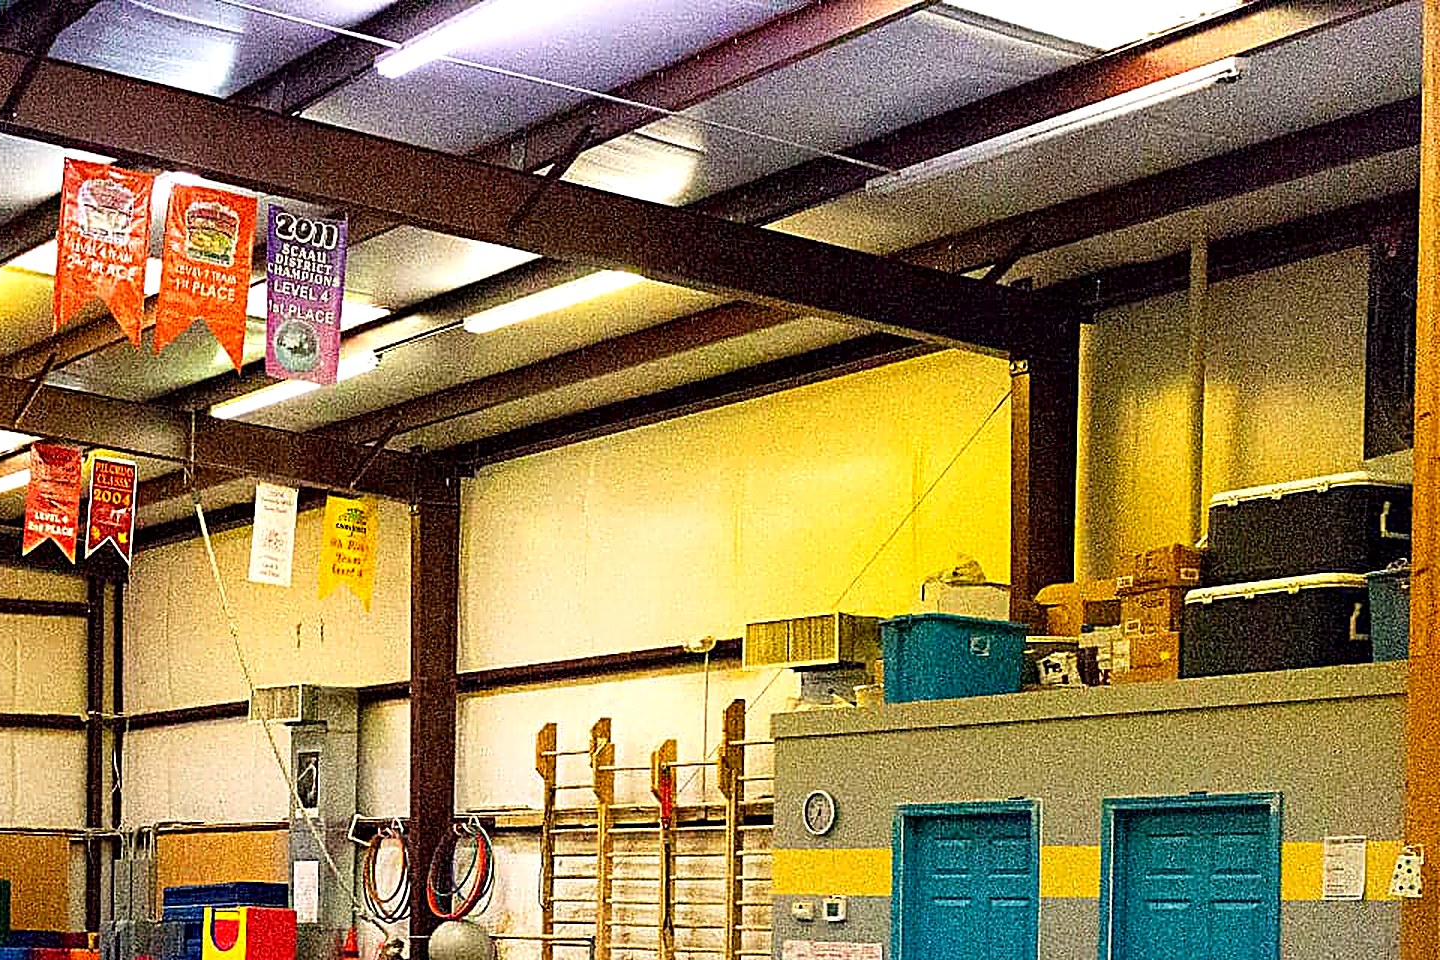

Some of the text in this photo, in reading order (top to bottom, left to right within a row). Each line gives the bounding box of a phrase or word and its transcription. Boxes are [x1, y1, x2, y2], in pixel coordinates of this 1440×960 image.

[275, 212, 339, 251] 2011
[275, 252, 334, 275] DISTRICT
[281, 242, 327, 265] SCAAU
[267, 262, 341, 289] CHAMPIONS
[191, 281, 236, 303] PLACE
[273, 278, 331, 303] LEVEL 4
[268, 298, 336, 326] 1st PLACE
[93, 487, 132, 507] 2004
[43, 523, 74, 537] PLACE
